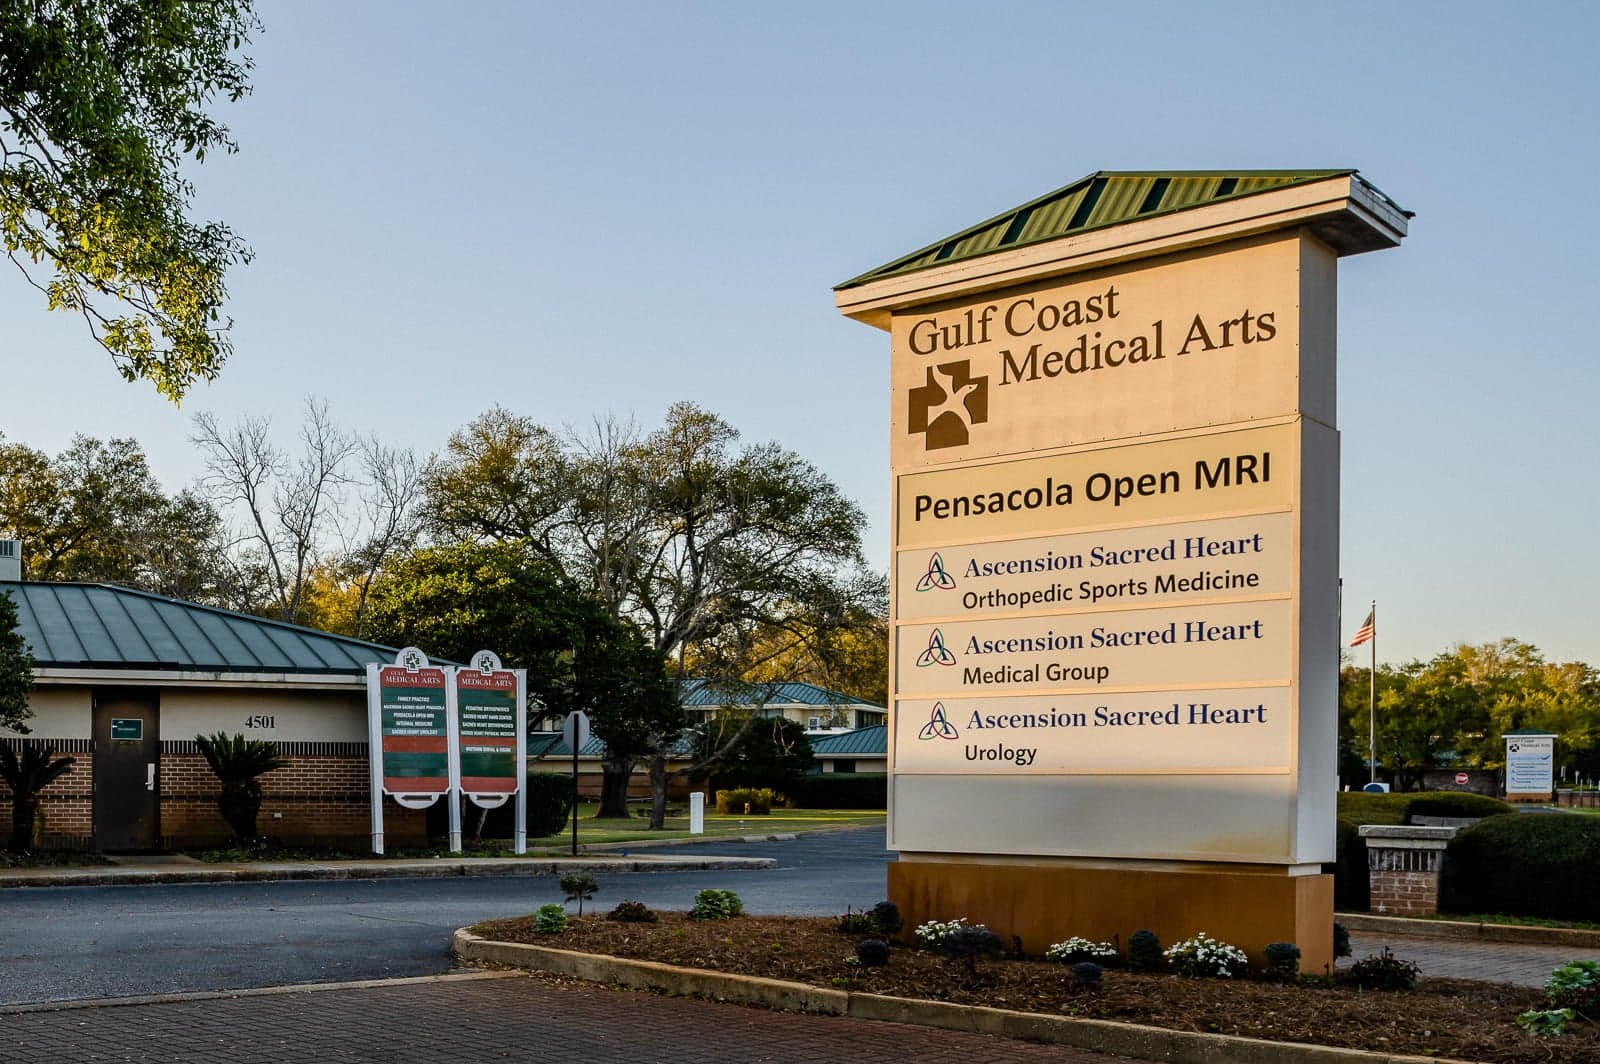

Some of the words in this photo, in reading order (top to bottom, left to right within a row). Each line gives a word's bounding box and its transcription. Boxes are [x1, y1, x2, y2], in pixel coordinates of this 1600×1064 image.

[908, 305, 998, 356] Gulf
[1004, 285, 1121, 338] Coast
[998, 319, 1167, 387] Medical
[1176, 309, 1278, 357] Arts
[914, 477, 1074, 522] Pensacola
[1085, 470, 1181, 507] Open
[1194, 451, 1271, 491] MRI
[963, 551, 1084, 579] Ascension
[1089, 538, 1177, 568] Sacred
[1183, 532, 1264, 560] Heart
[962, 583, 1073, 610] Orthopedic
[1079, 579, 1148, 606] Sports
[1154, 570, 1260, 595] Medicine
[963, 629, 1085, 656] Ascension
[1090, 622, 1177, 649] Sacred
[1183, 618, 1264, 643] Heart
[385, 675, 418, 683] MEDICAL
[462, 678, 492, 686] MEDICAL
[962, 663, 1040, 686] Medical
[1045, 662, 1110, 685] Group
[245, 715, 275, 729] 4501
[965, 706, 1088, 730] Ascension
[1093, 703, 1181, 728] Sacred
[1186, 702, 1268, 725] Heart
[965, 743, 1037, 767] Urology
